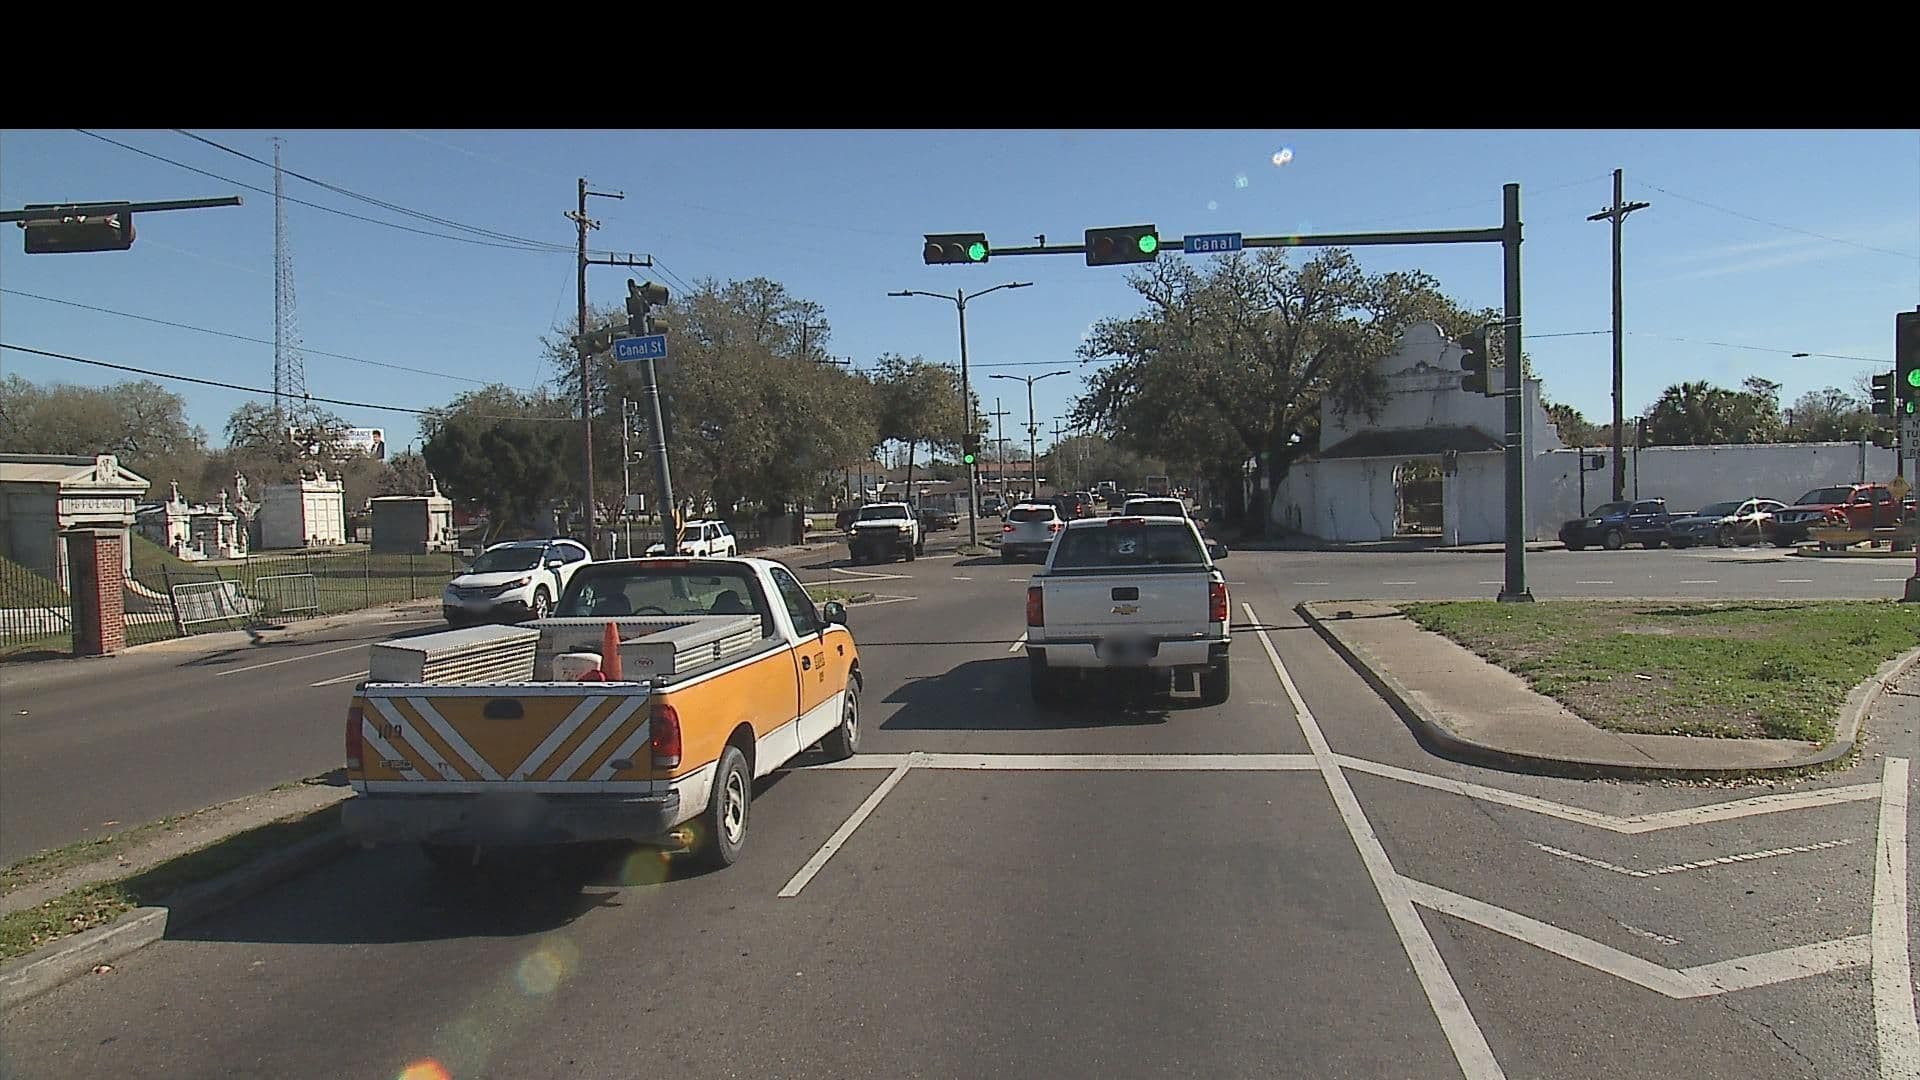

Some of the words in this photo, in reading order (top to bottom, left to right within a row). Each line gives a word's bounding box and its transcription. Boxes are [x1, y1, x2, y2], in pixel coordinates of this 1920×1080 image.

[1194, 236, 1232, 250] Canal
[619, 343, 648, 357] Canal
[651, 340, 662, 353] St
